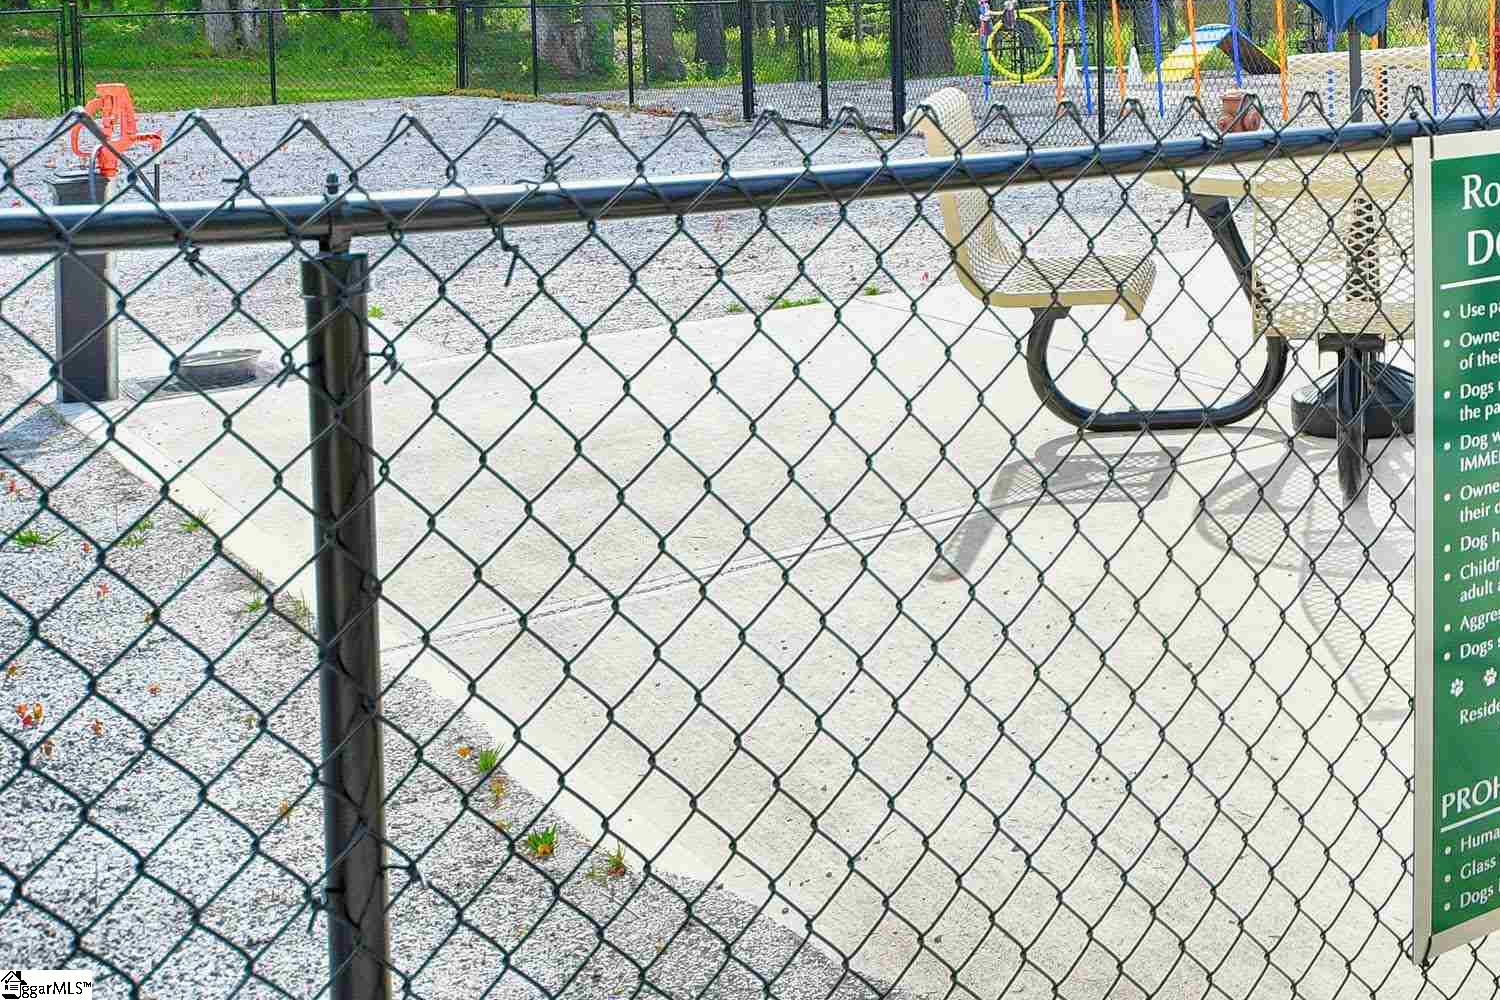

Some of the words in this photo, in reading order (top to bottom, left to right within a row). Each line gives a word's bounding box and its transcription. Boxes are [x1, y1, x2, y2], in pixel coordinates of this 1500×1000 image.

[1460, 303, 1486, 319] Use
[1459, 352, 1474, 370] of
[1460, 381, 1494, 400] Dogs
[1459, 404, 1481, 422] the
[1460, 434, 1488, 450] Dog
[1459, 502, 1491, 523] their
[1460, 535, 1488, 552] Dog
[1459, 579, 1493, 603] adult
[1460, 639, 1494, 659] Dogs
[1460, 856, 1497, 880] Glass
[1460, 885, 1494, 909] Dogs
